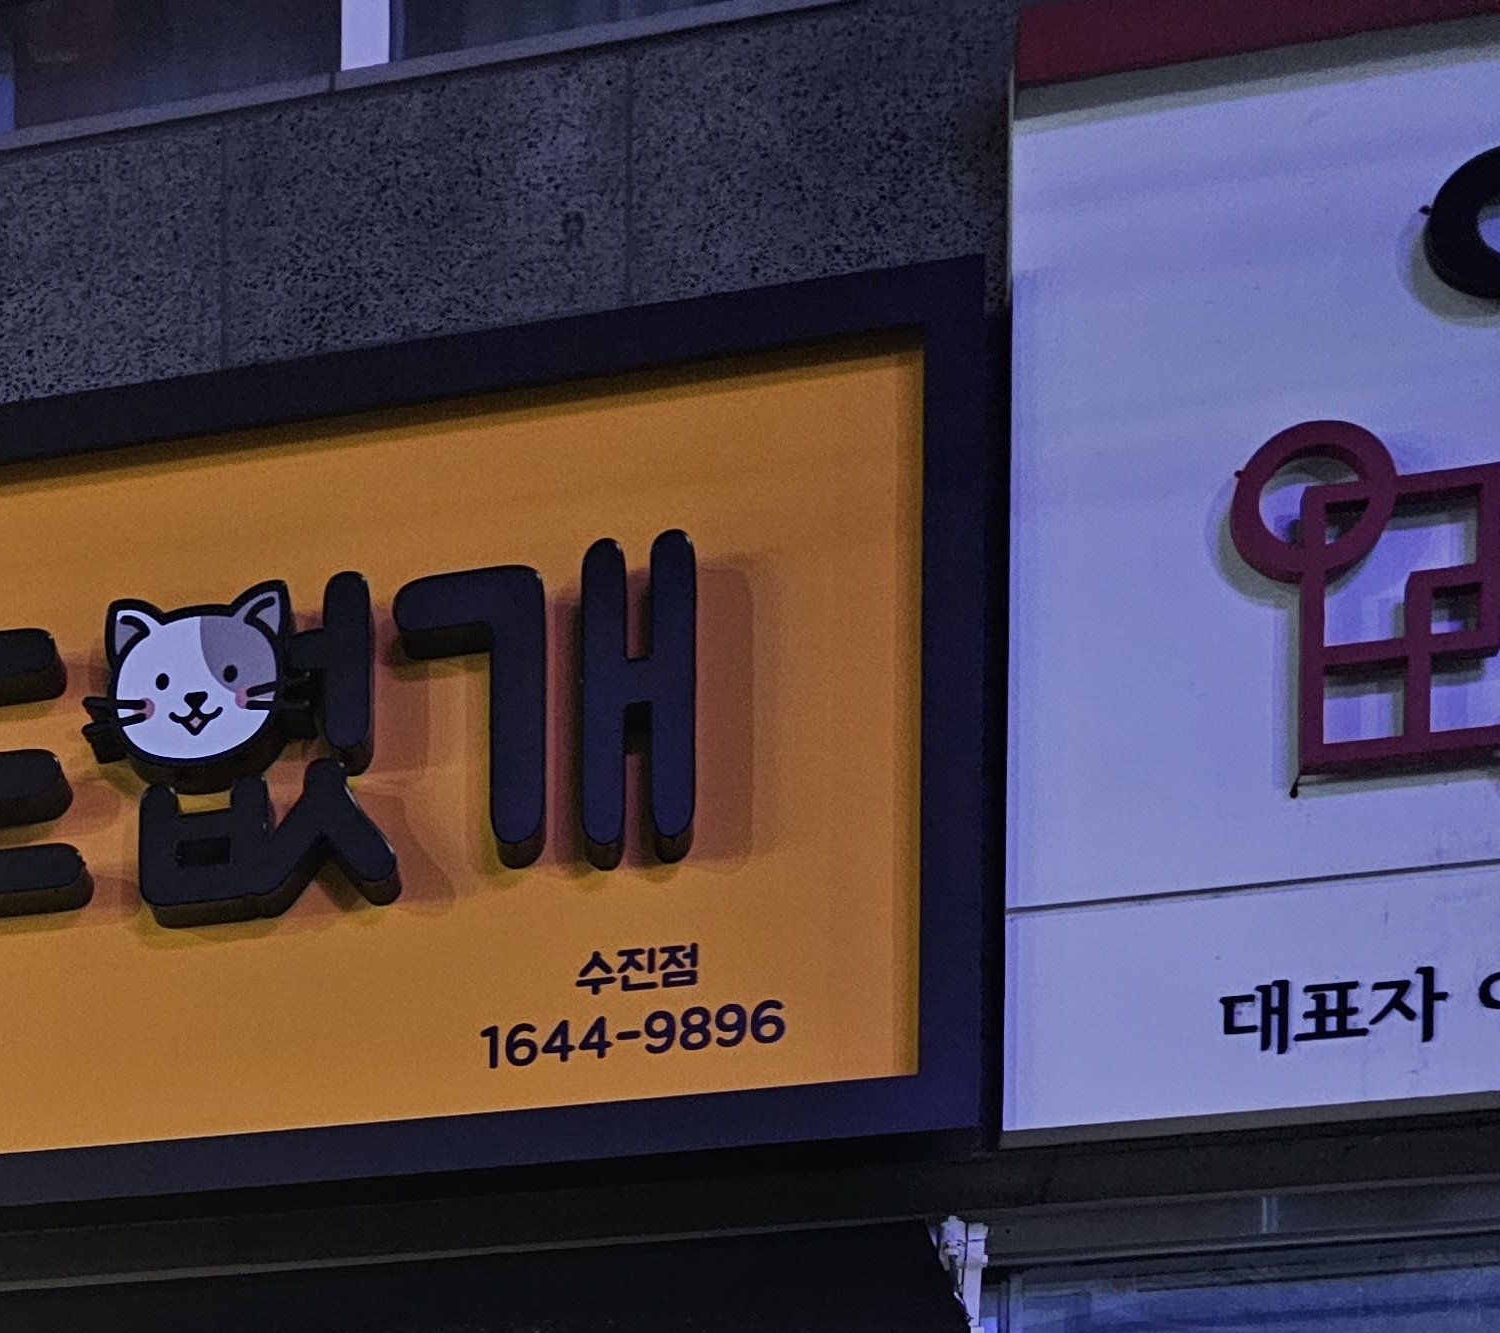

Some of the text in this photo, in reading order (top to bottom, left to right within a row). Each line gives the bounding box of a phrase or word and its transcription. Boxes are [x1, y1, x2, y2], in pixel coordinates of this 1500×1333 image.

[576, 942, 700, 995] 수진점
[481, 1000, 786, 1069] 1644-9896
[1219, 965, 1447, 1053] 대표자
